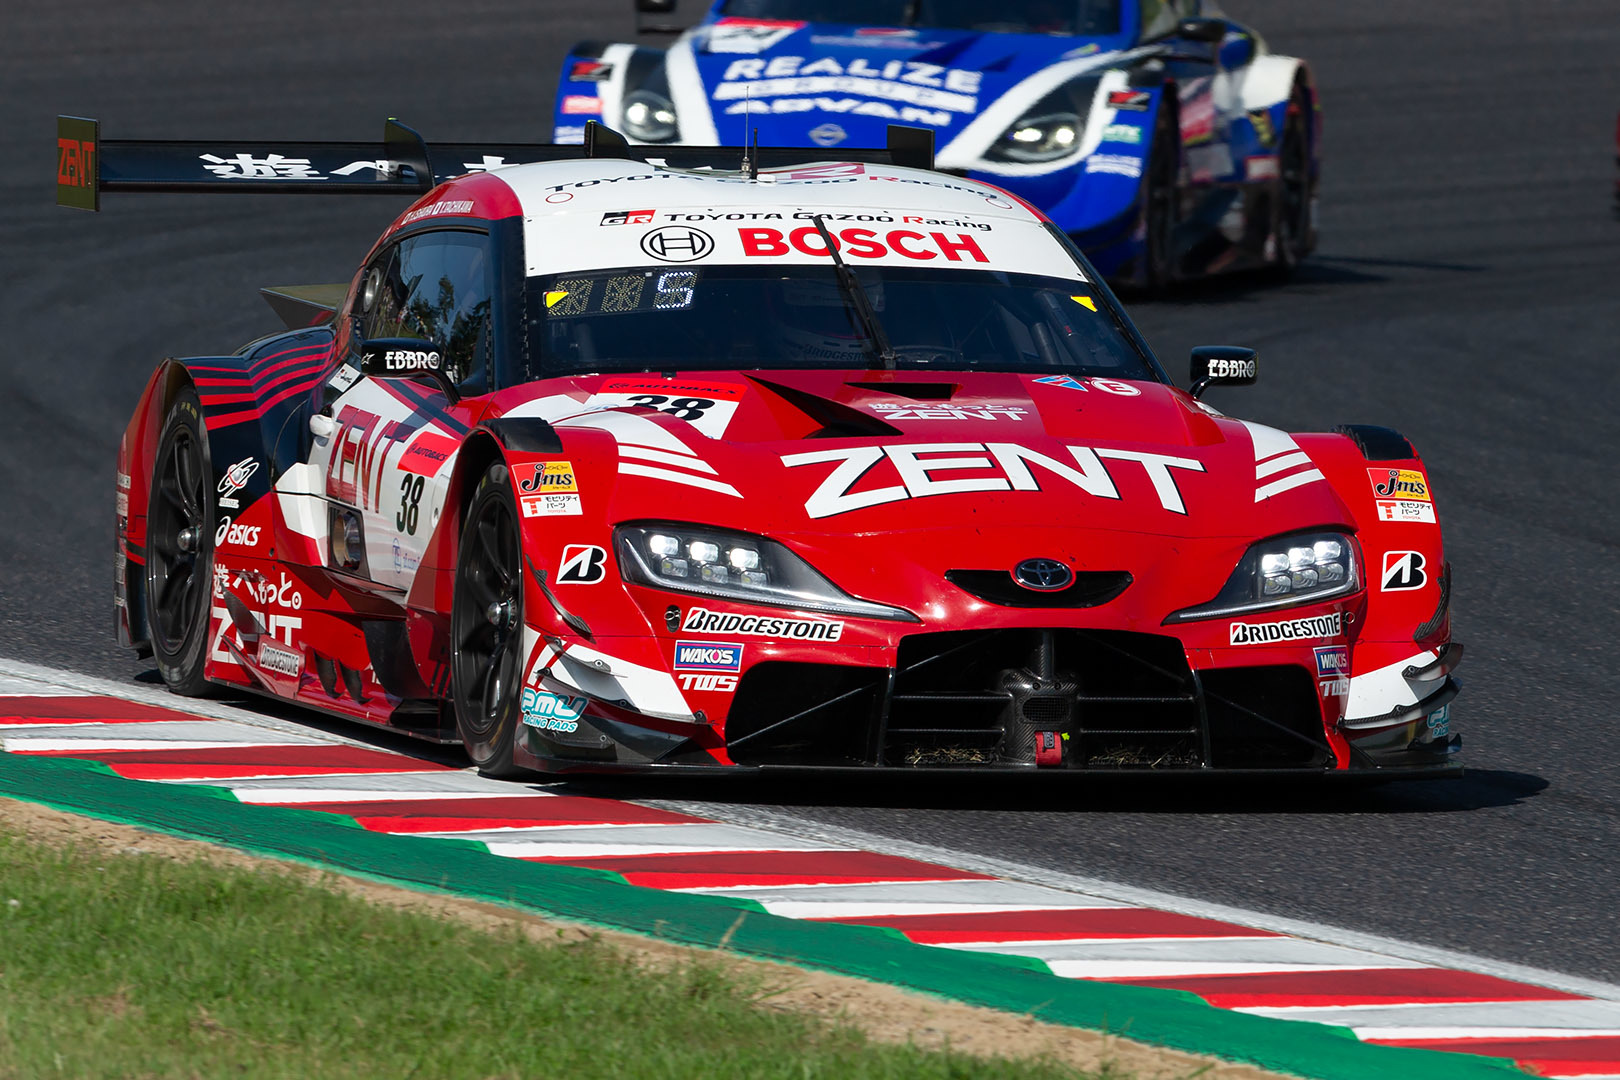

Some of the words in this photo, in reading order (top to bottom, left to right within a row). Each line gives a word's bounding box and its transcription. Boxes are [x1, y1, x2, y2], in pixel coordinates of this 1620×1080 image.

[723, 56, 984, 94] REALIZE
[58, 138, 95, 187] ZENT
[601, 211, 654, 226] GR
[664, 212, 782, 222] TOYOTA
[793, 212, 895, 223] GAZOO
[903, 216, 992, 231] Racing
[738, 227, 990, 264] BOSCH
[385, 350, 440, 370] EBBRO
[1207, 359, 1256, 378] EBBRO
[631, 384, 738, 394] AUTOBACS
[875, 409, 1029, 421] ZENT
[326, 404, 418, 514] ZENT
[413, 447, 449, 463] AUTOBACS
[780, 442, 1208, 519] ZENT
[396, 472, 426, 536] 38
[227, 523, 262, 546] asics
[684, 608, 843, 641] BRIDGESTONE
[1231, 613, 1340, 643] BRIDGESTONE
[261, 645, 299, 676] BRIDGESTONE
[678, 674, 739, 692] TWS
[523, 714, 548, 728] RACING
[548, 719, 577, 732] PADS
